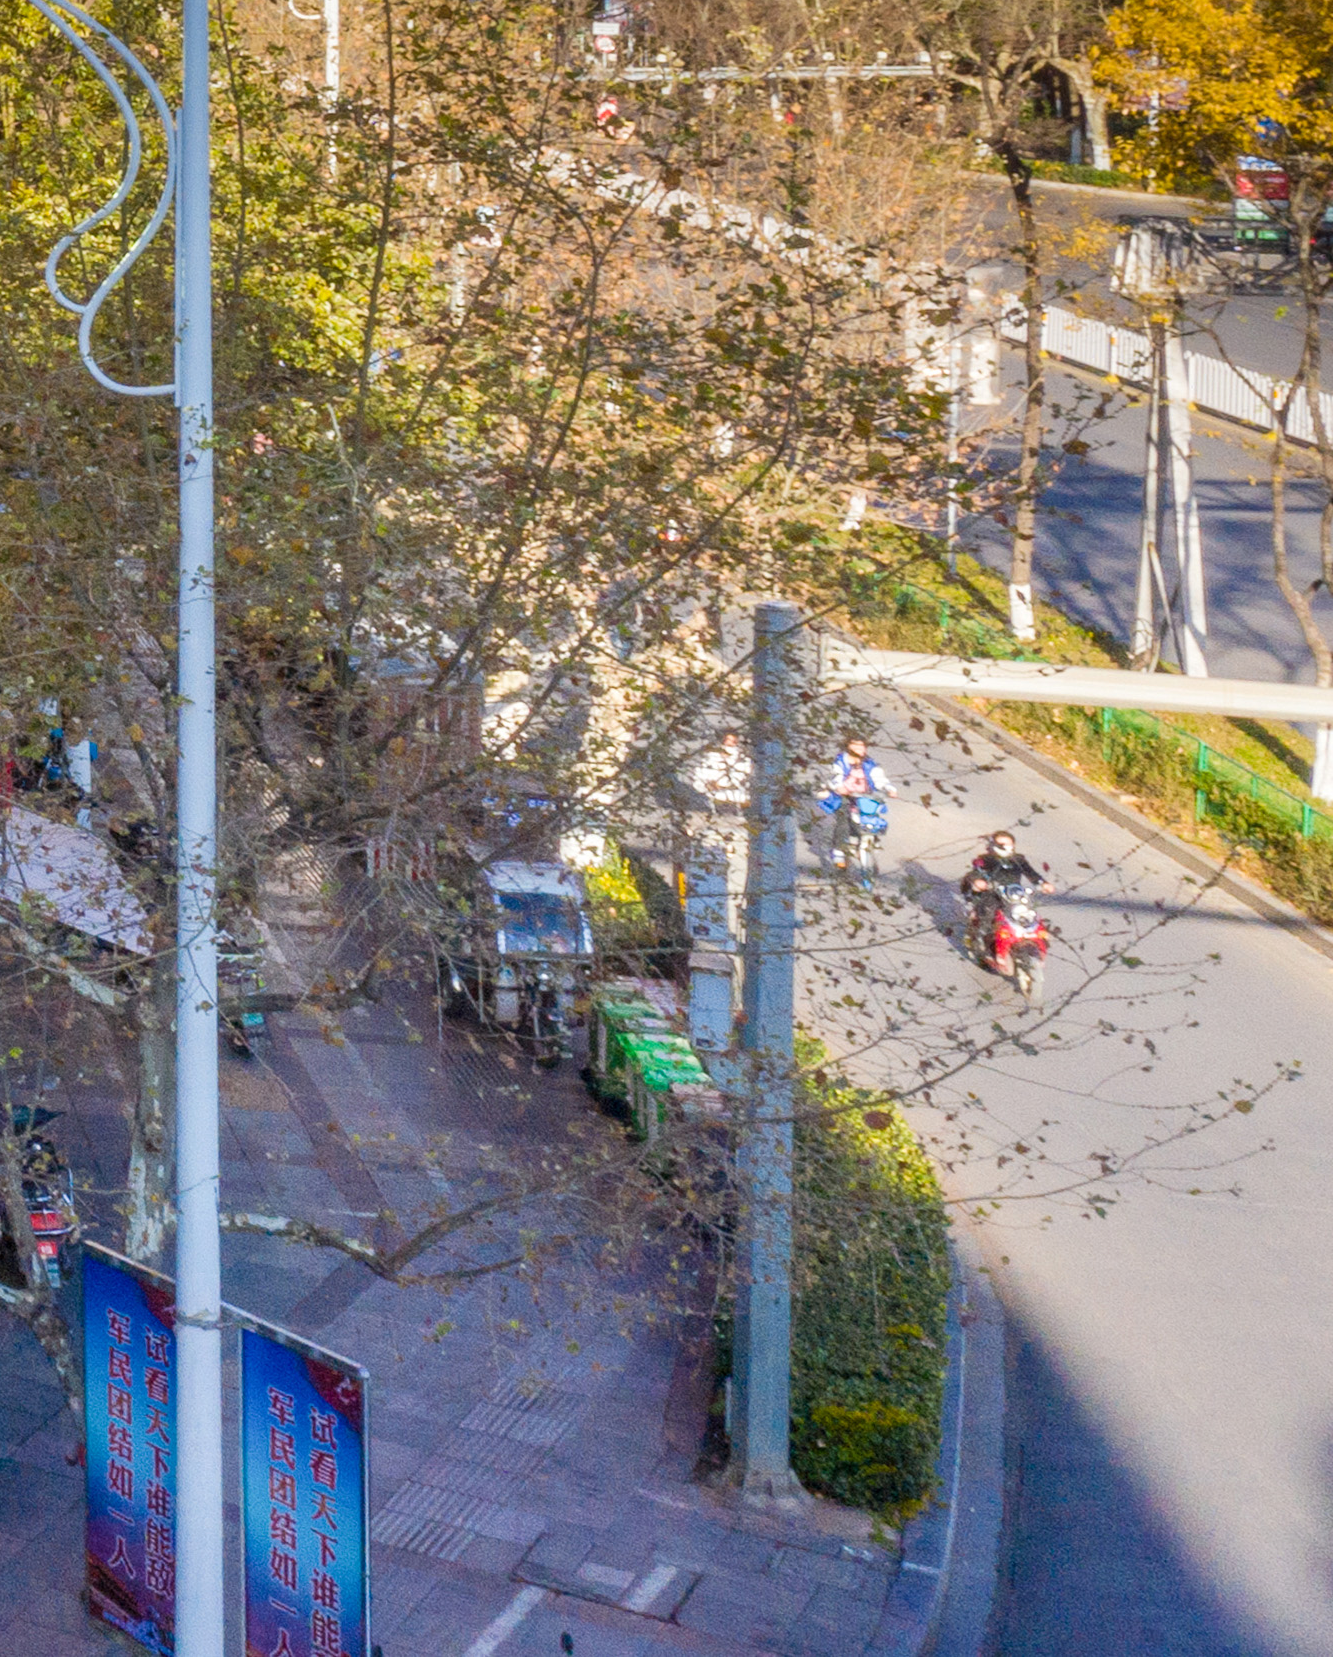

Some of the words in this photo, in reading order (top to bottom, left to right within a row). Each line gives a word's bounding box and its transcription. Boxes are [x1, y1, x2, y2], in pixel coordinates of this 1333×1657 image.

[107, 1308, 135, 1579] 军民团结如一人
[145, 1327, 174, 1599] 试看天下谁能敌
[310, 1406, 340, 1657] 试看天下谁能
